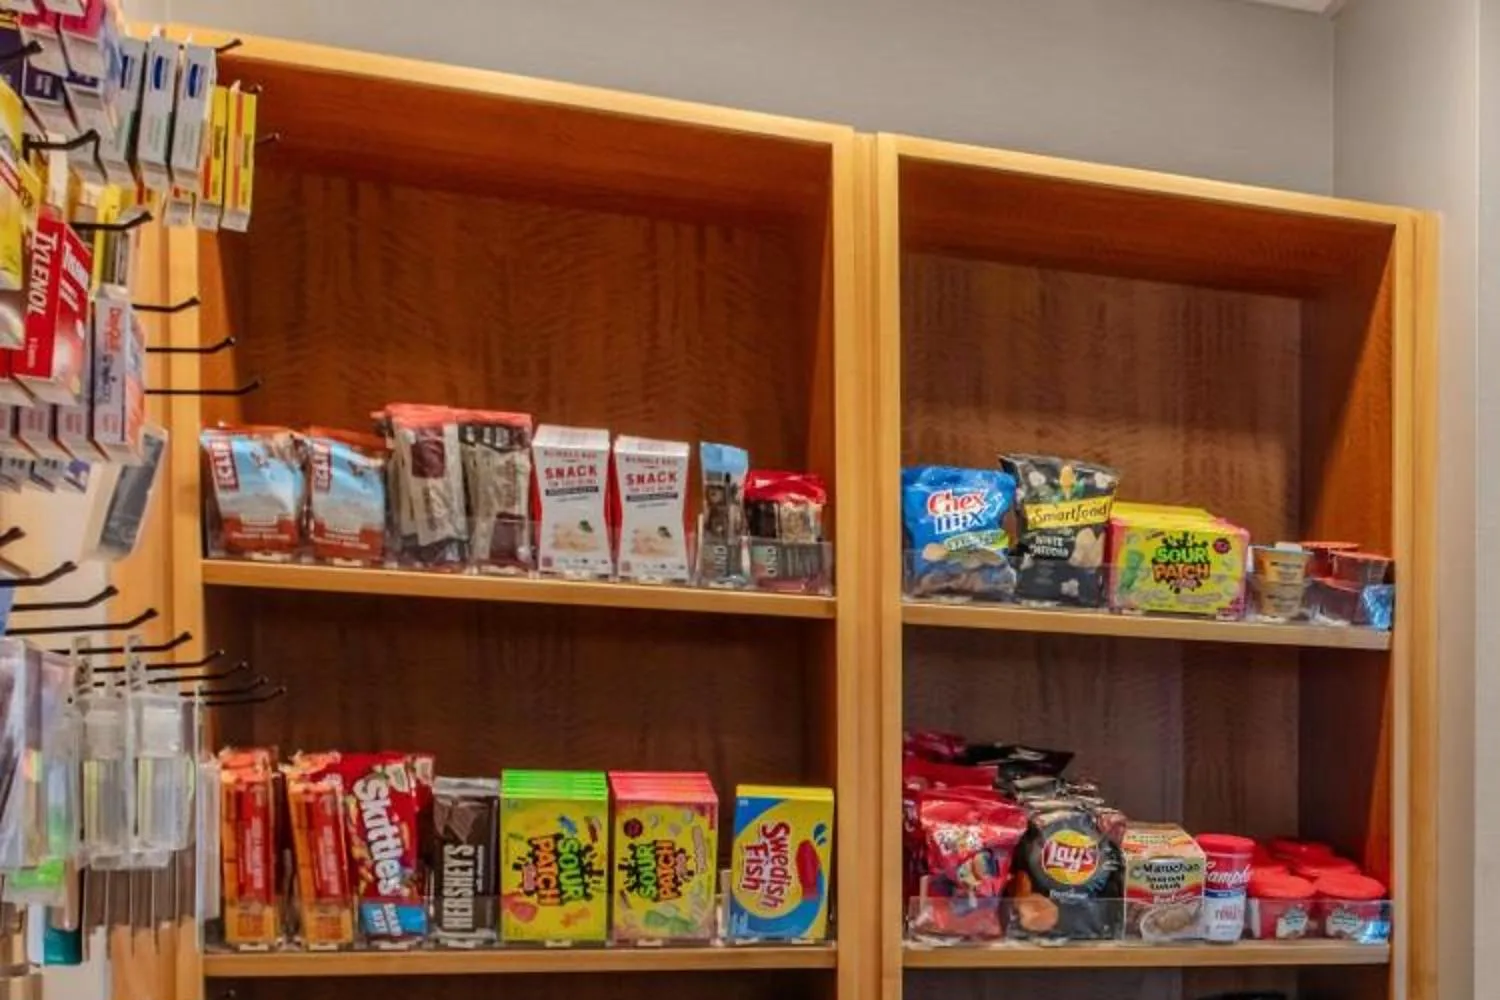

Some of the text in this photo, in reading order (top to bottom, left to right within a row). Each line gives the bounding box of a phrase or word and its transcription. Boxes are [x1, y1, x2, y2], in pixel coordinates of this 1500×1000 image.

[28, 231, 58, 316] TYLENOL
[544, 464, 598, 480] SNACK
[626, 472, 678, 484] SNACK
[926, 487, 987, 517] Chex
[1030, 500, 1113, 526] Smartfood
[1153, 562, 1211, 580] PATCH
[1155, 547, 1209, 563] SOUR
[353, 777, 403, 896] Skittles
[530, 836, 560, 905] PATCH
[558, 836, 585, 899] SOUR
[741, 842, 769, 891] Fish
[761, 821, 791, 908] Swedish
